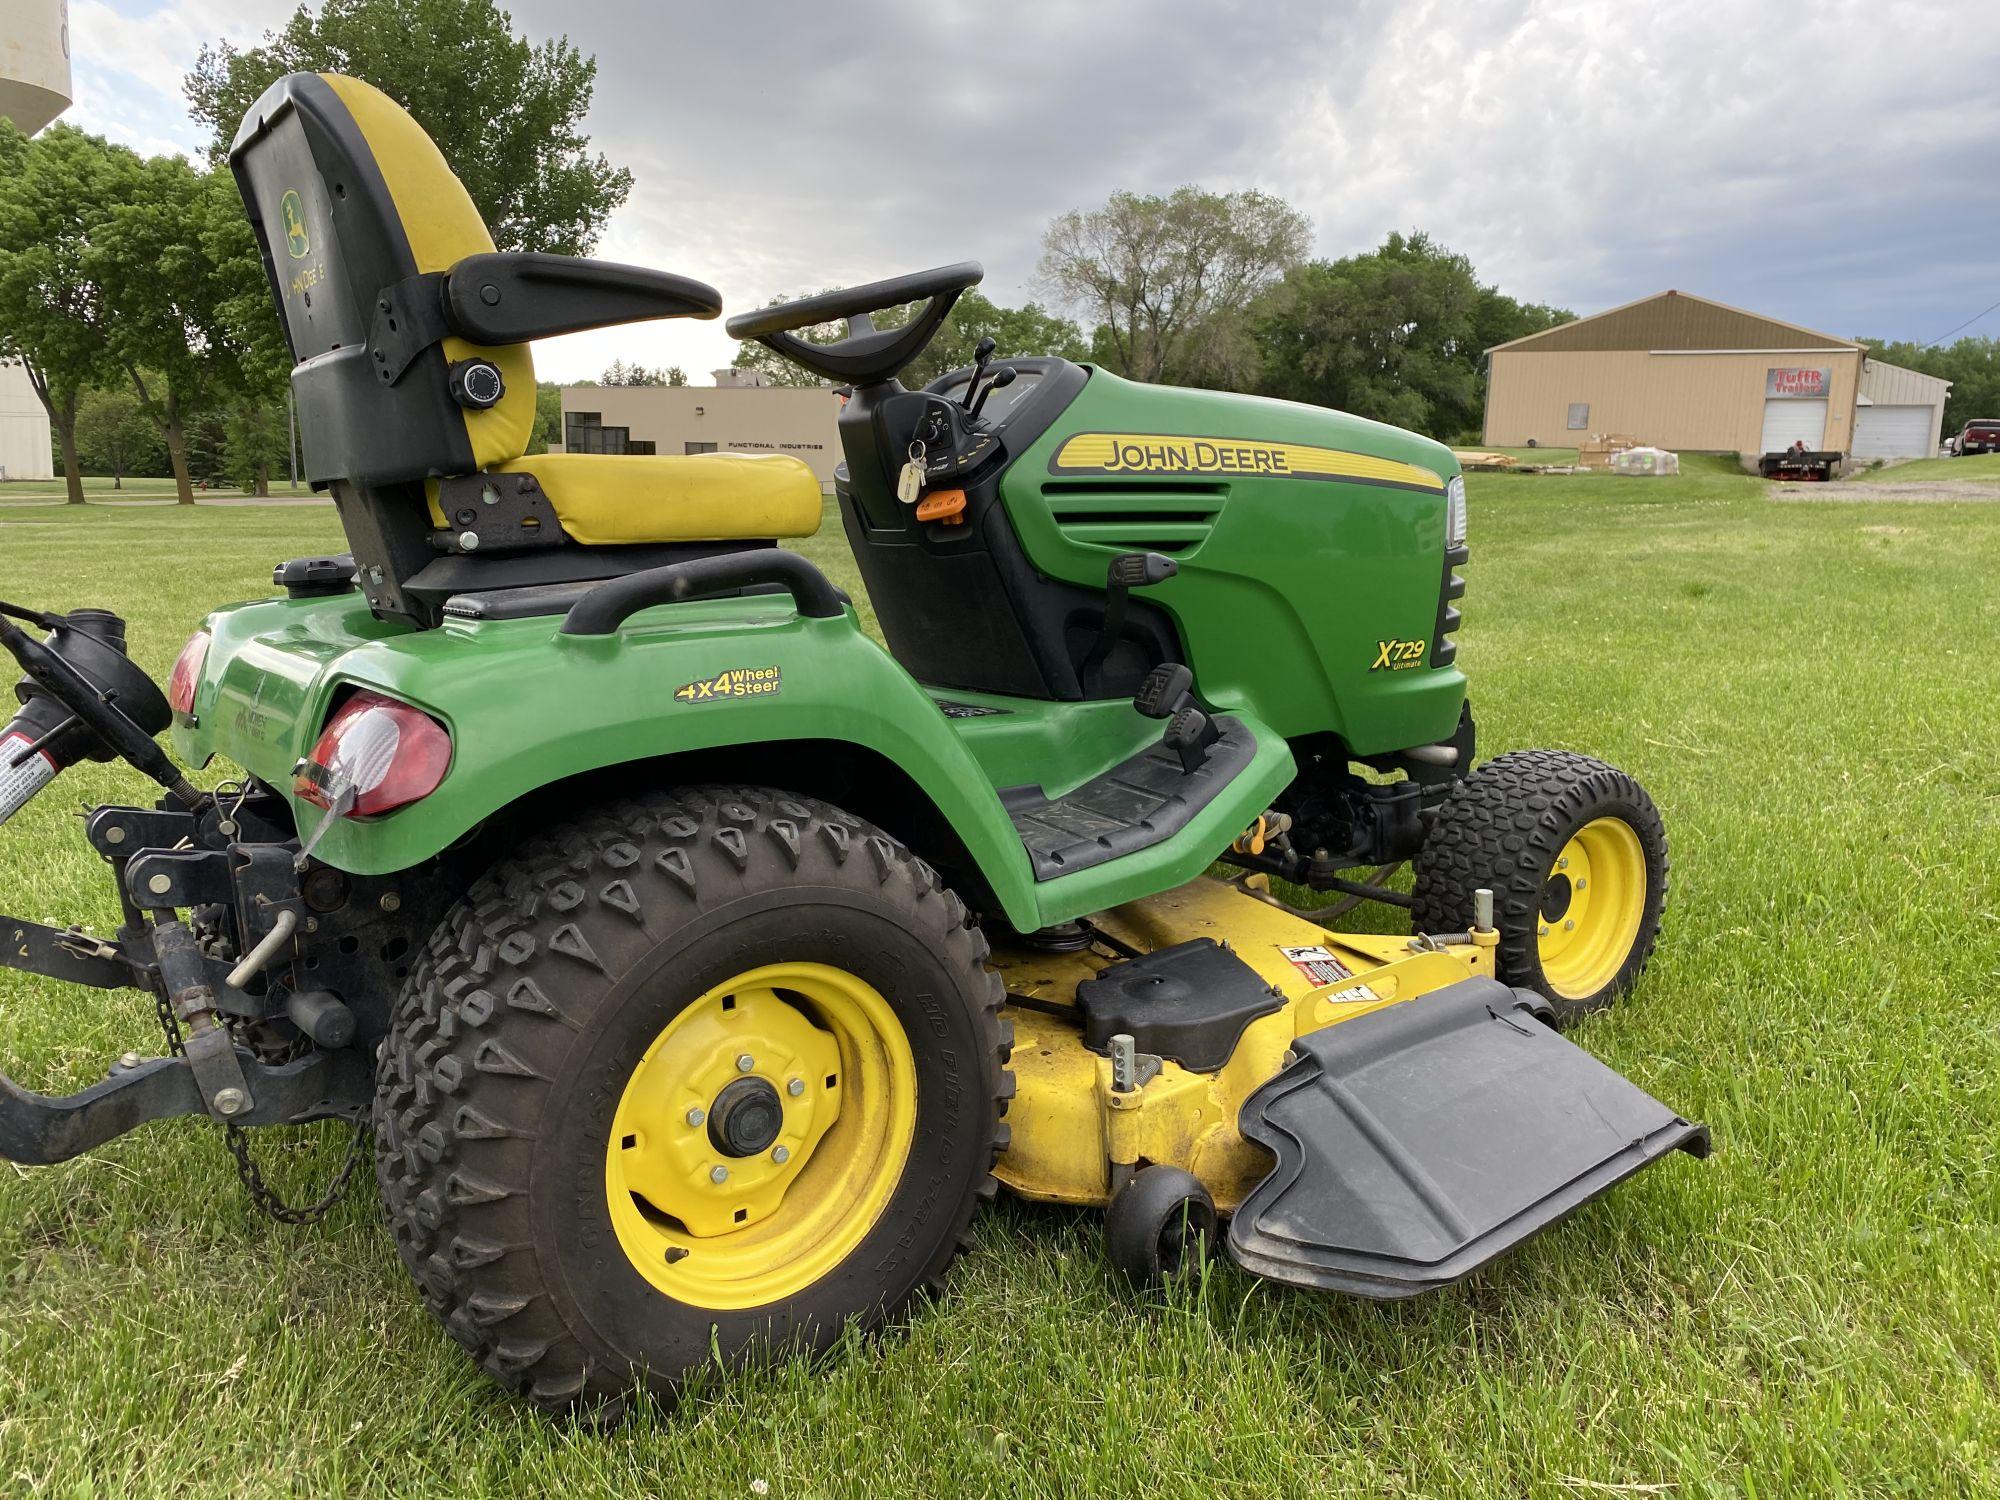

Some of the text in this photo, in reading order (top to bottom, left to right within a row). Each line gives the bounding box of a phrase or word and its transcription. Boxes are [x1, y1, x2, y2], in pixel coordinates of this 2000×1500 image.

[1103, 440, 1289, 471] JOHN DEERE
[1371, 639, 1425, 669] X729
[1393, 660, 1421, 671] Ultimate
[731, 665, 778, 683] Wheel
[733, 681, 779, 696] Steer
[19, 770, 34, 785] KEEP
